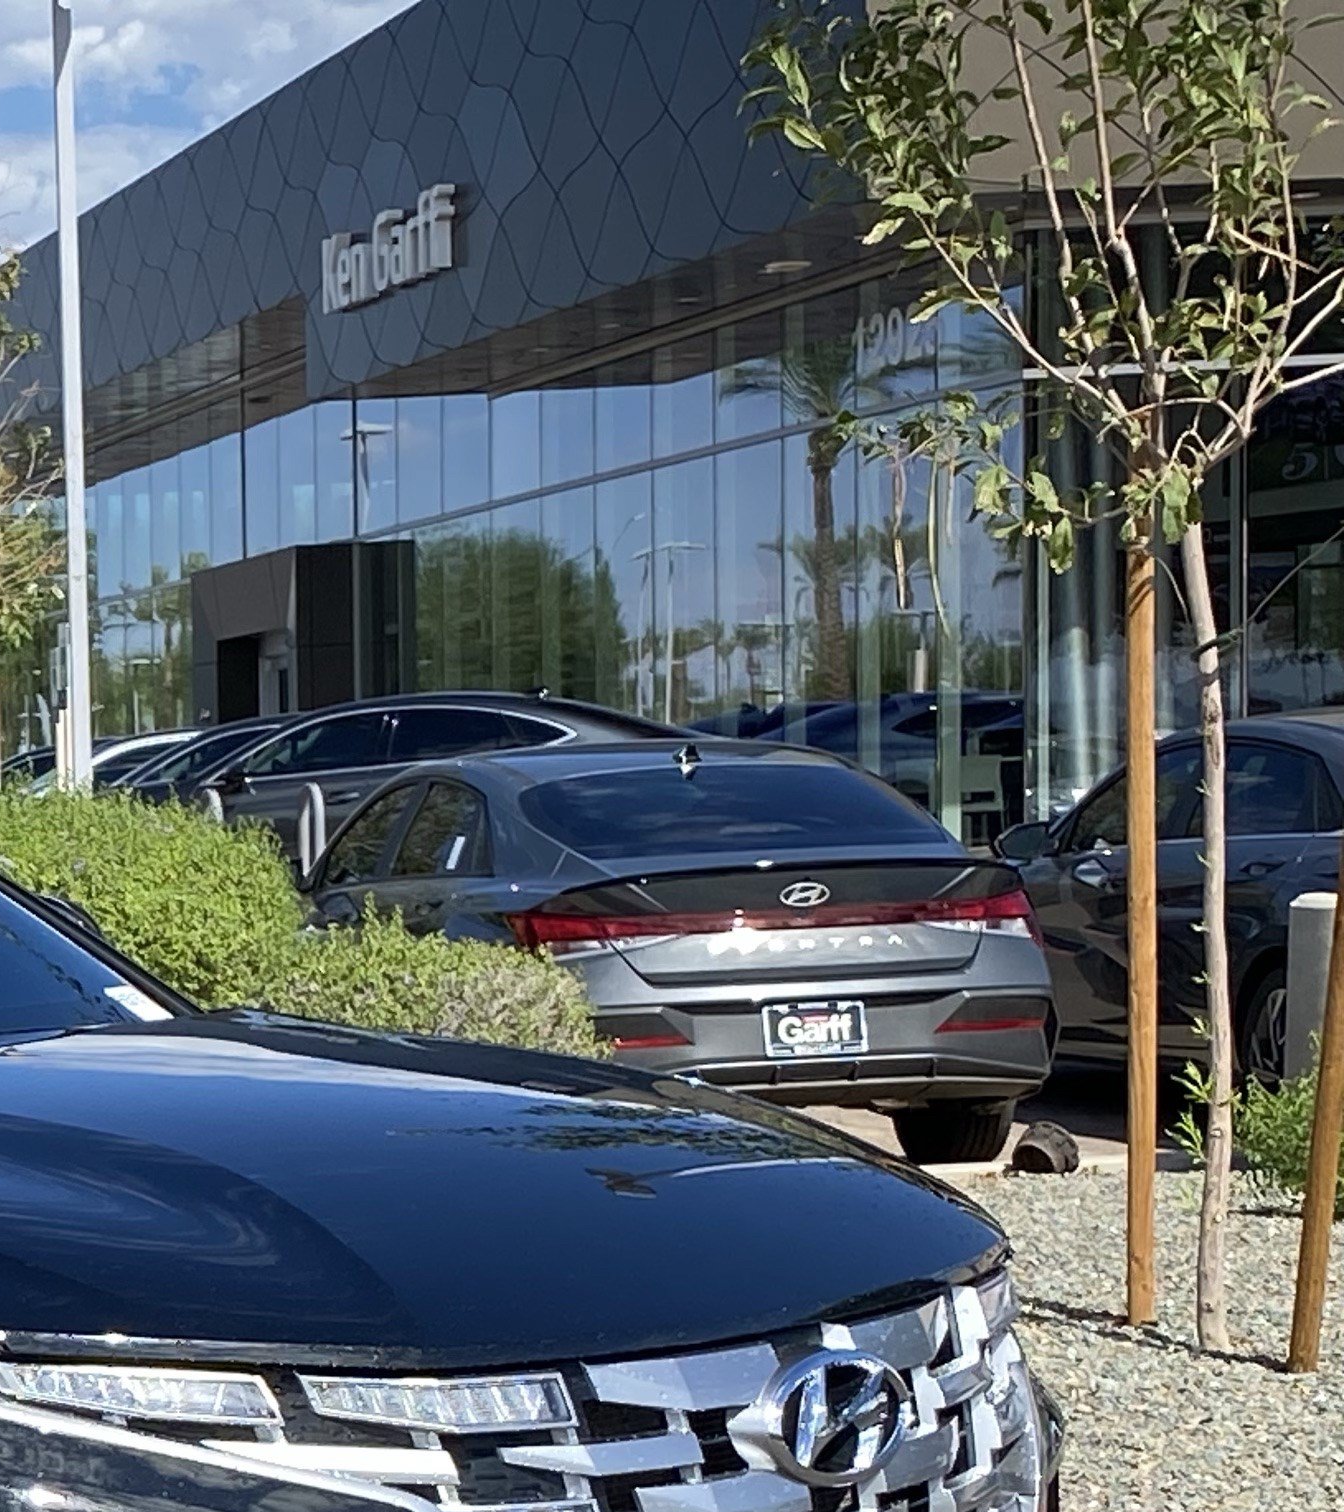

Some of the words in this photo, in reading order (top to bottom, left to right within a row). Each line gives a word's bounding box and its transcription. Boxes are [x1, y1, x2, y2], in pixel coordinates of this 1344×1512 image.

[321, 232, 379, 315] Ken
[372, 182, 456, 291] Garff
[777, 1012, 852, 1044] Garff
